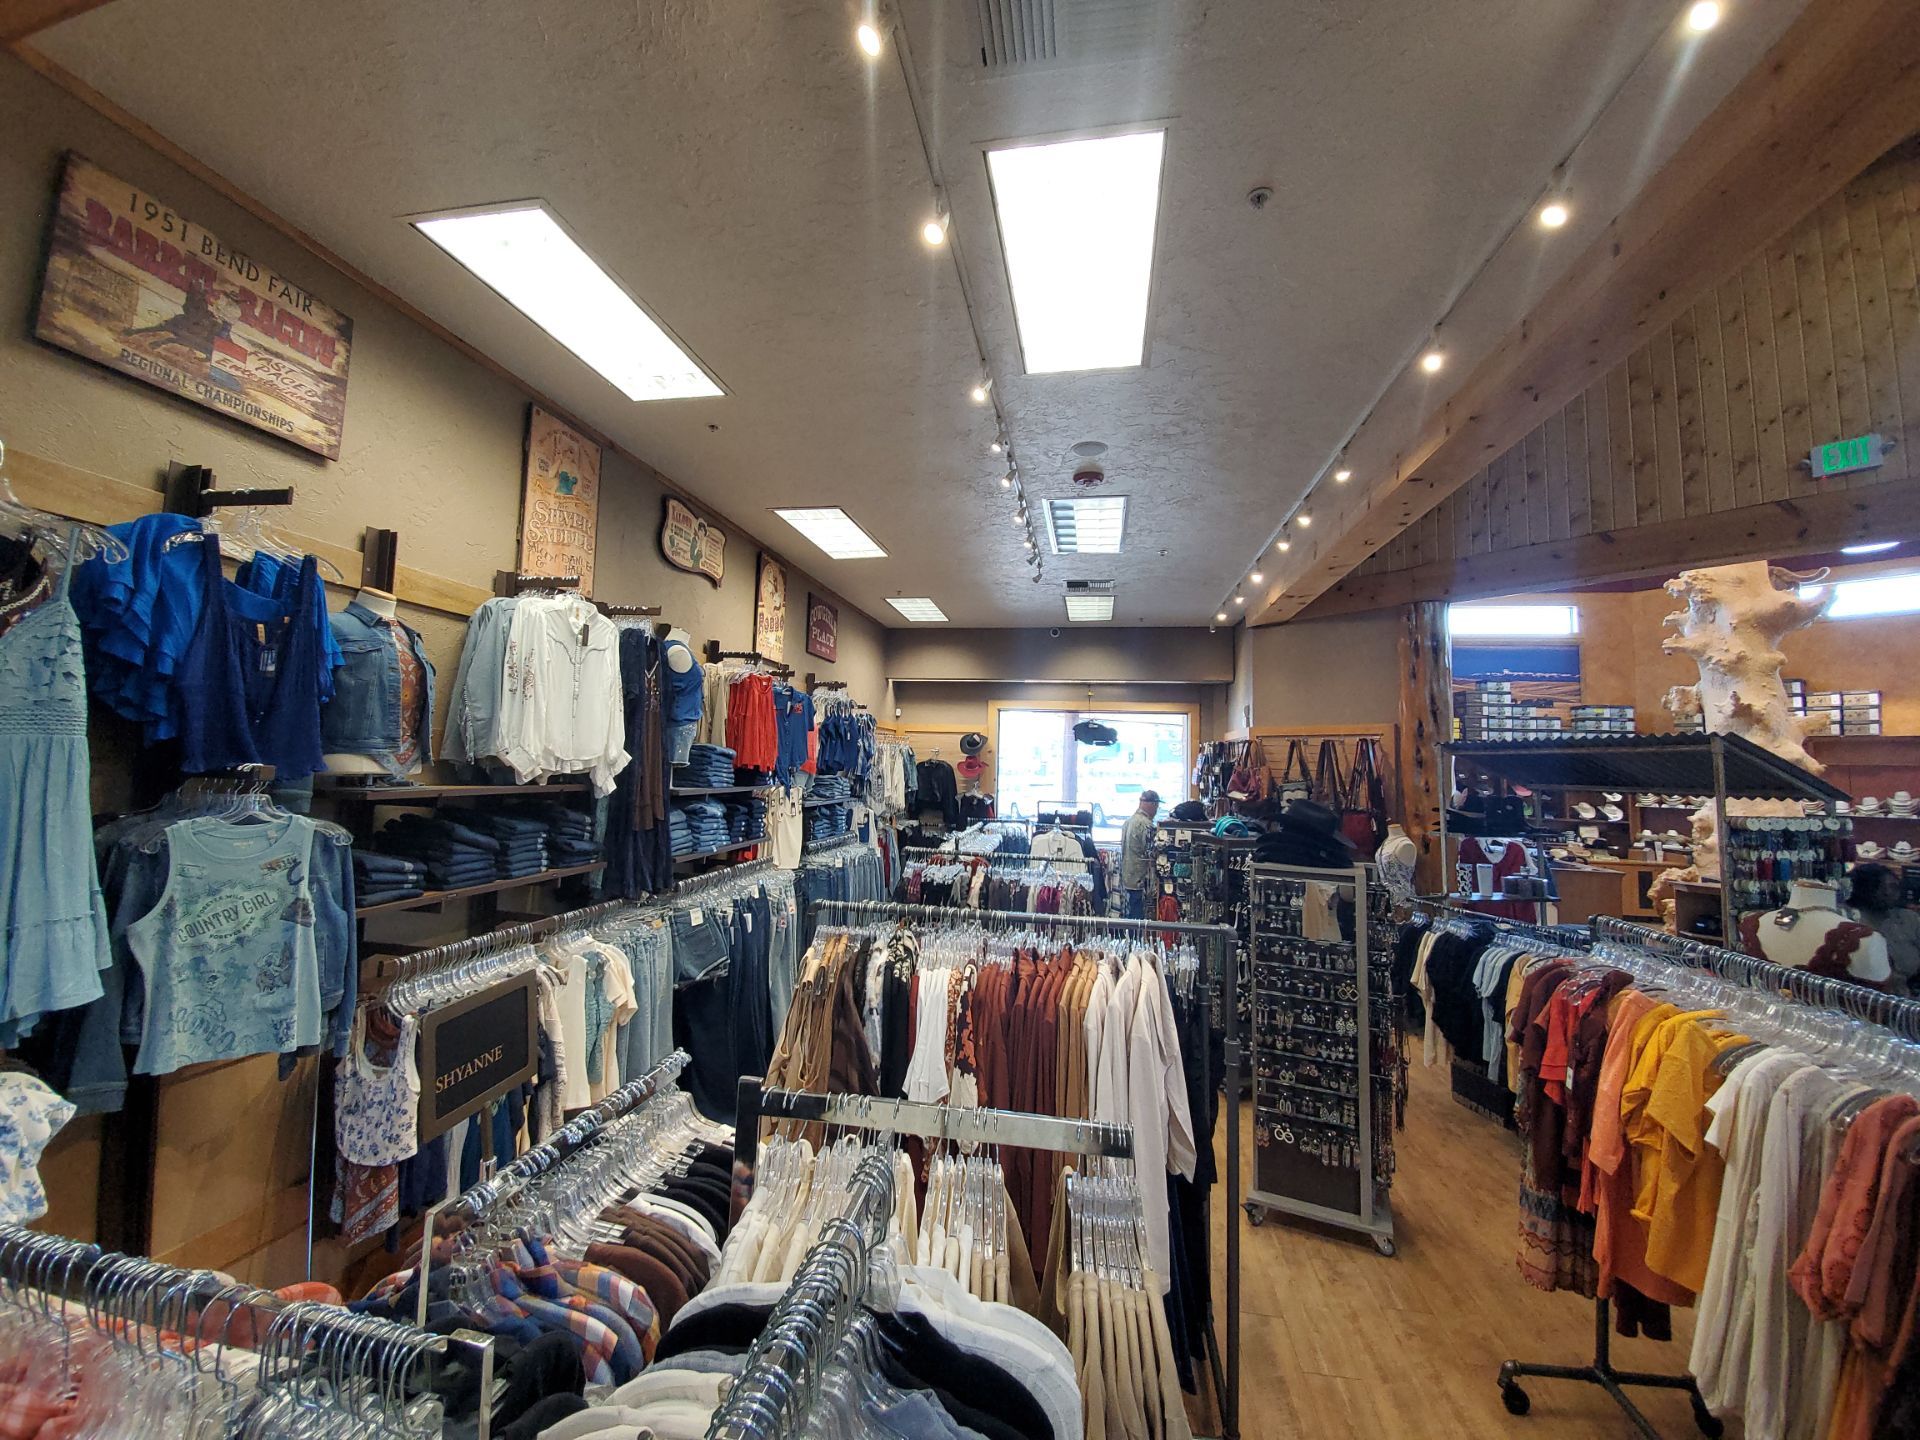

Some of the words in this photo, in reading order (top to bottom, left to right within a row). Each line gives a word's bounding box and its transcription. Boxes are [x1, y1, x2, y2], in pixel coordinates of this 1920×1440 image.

[129, 192, 188, 242] 1951
[200, 234, 260, 282] BEND
[267, 275, 313, 317] FAIR
[120, 347, 188, 388] REGIONAL
[194, 380, 295, 433] CHAMPIONSHIPS
[254, 363, 320, 400] PACED
[1823, 435, 1870, 473] EXIT
[811, 626, 835, 648] PLACE
[178, 904, 239, 943] COUNTRY
[242, 891, 276, 914] GIRL
[435, 1044, 504, 1094] SHYANNE
